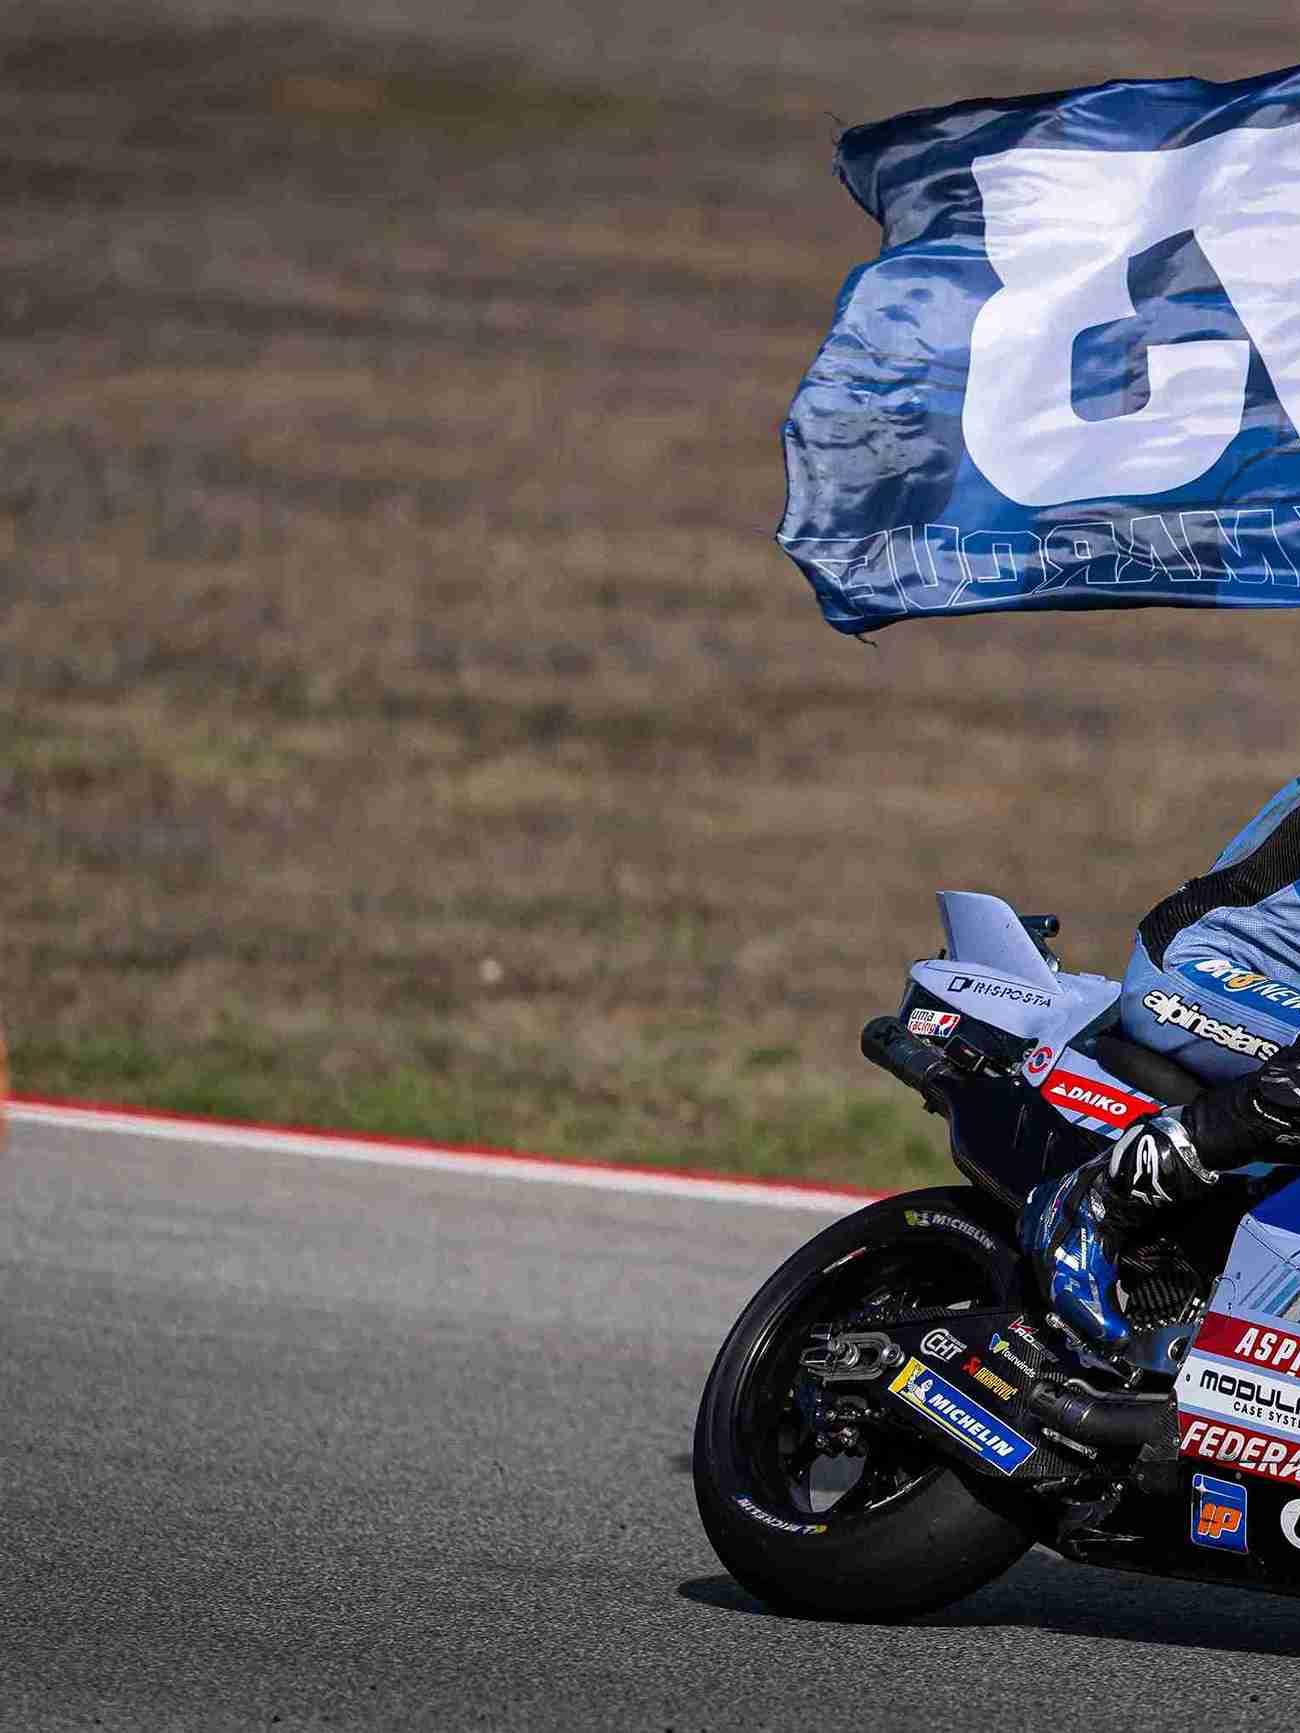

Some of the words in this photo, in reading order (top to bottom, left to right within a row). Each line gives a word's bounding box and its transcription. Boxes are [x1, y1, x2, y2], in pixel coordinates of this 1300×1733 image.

[973, 981, 1052, 1008] RISPOSTA
[1143, 989, 1281, 1061] alpinestars
[1067, 1085, 1128, 1116] DAIKO
[931, 1213, 998, 1251] MICHELIN
[928, 1389, 1016, 1458] MICHELIN
[1233, 1401, 1264, 1419] CASE
